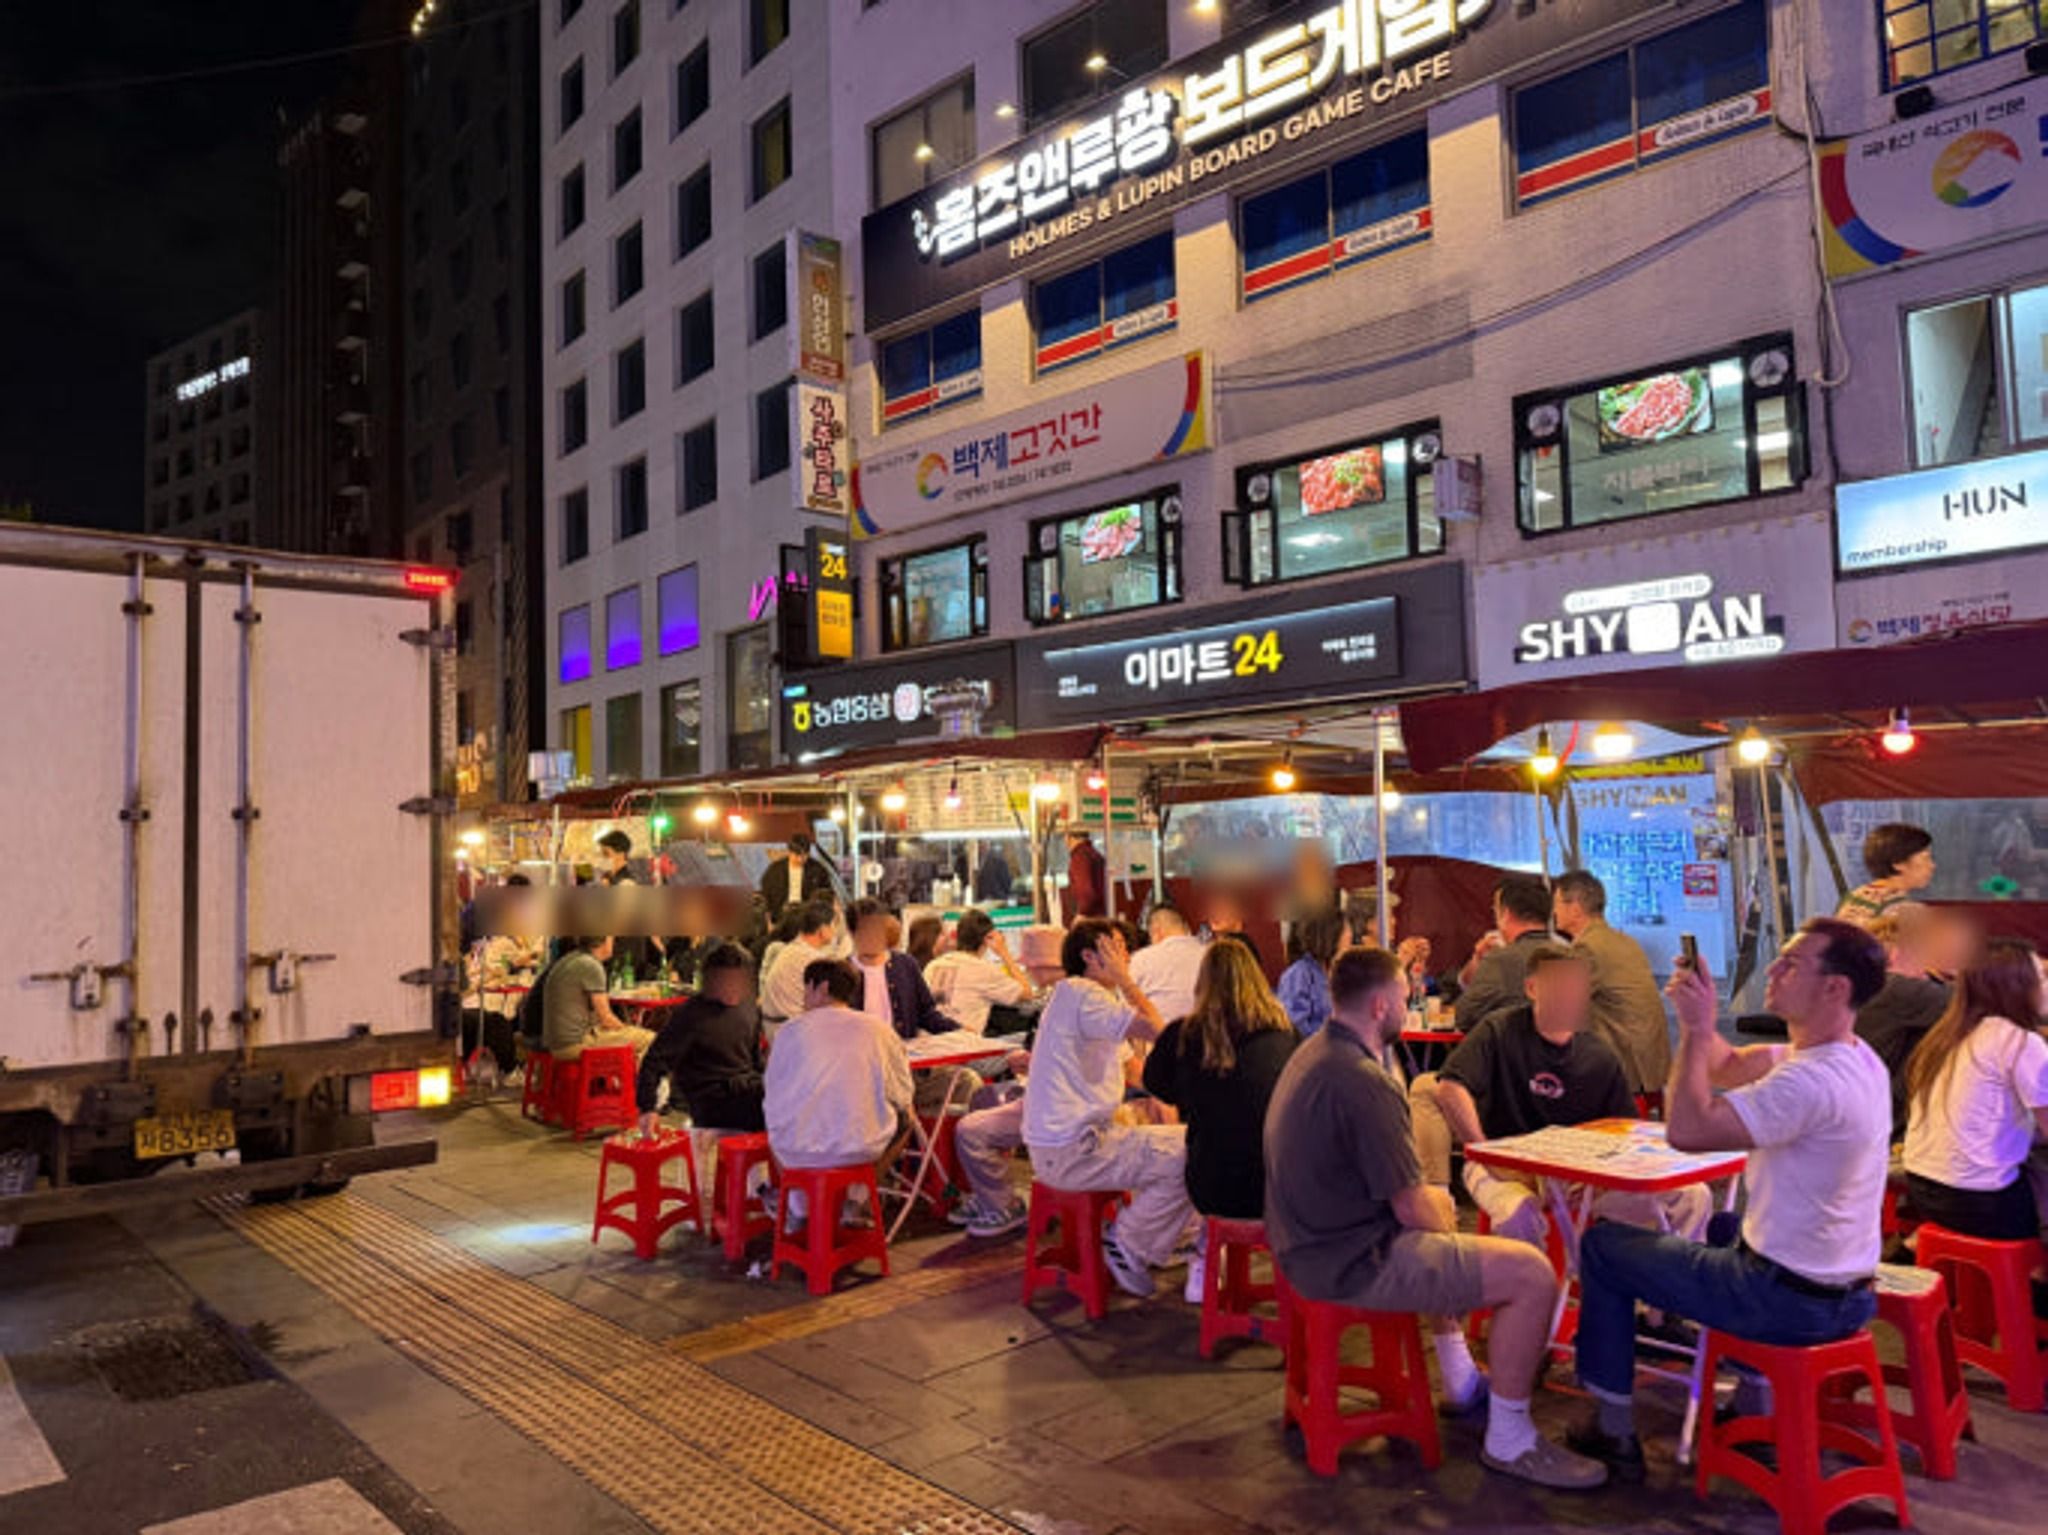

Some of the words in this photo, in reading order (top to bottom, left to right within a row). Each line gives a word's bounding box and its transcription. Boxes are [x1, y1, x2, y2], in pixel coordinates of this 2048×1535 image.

[1010, 206, 1093, 258] HOLMES
[1097, 200, 1113, 221] &
[1118, 164, 1184, 211] LUPIN
[1190, 127, 1277, 180] BOARD
[1283, 87, 1364, 139] GAME
[1370, 50, 1452, 104] CAFE
[953, 403, 1103, 478] 백제고깃간
[1943, 481, 2028, 521] HUN
[821, 553, 847, 581] 24
[1847, 539, 1948, 564] membership
